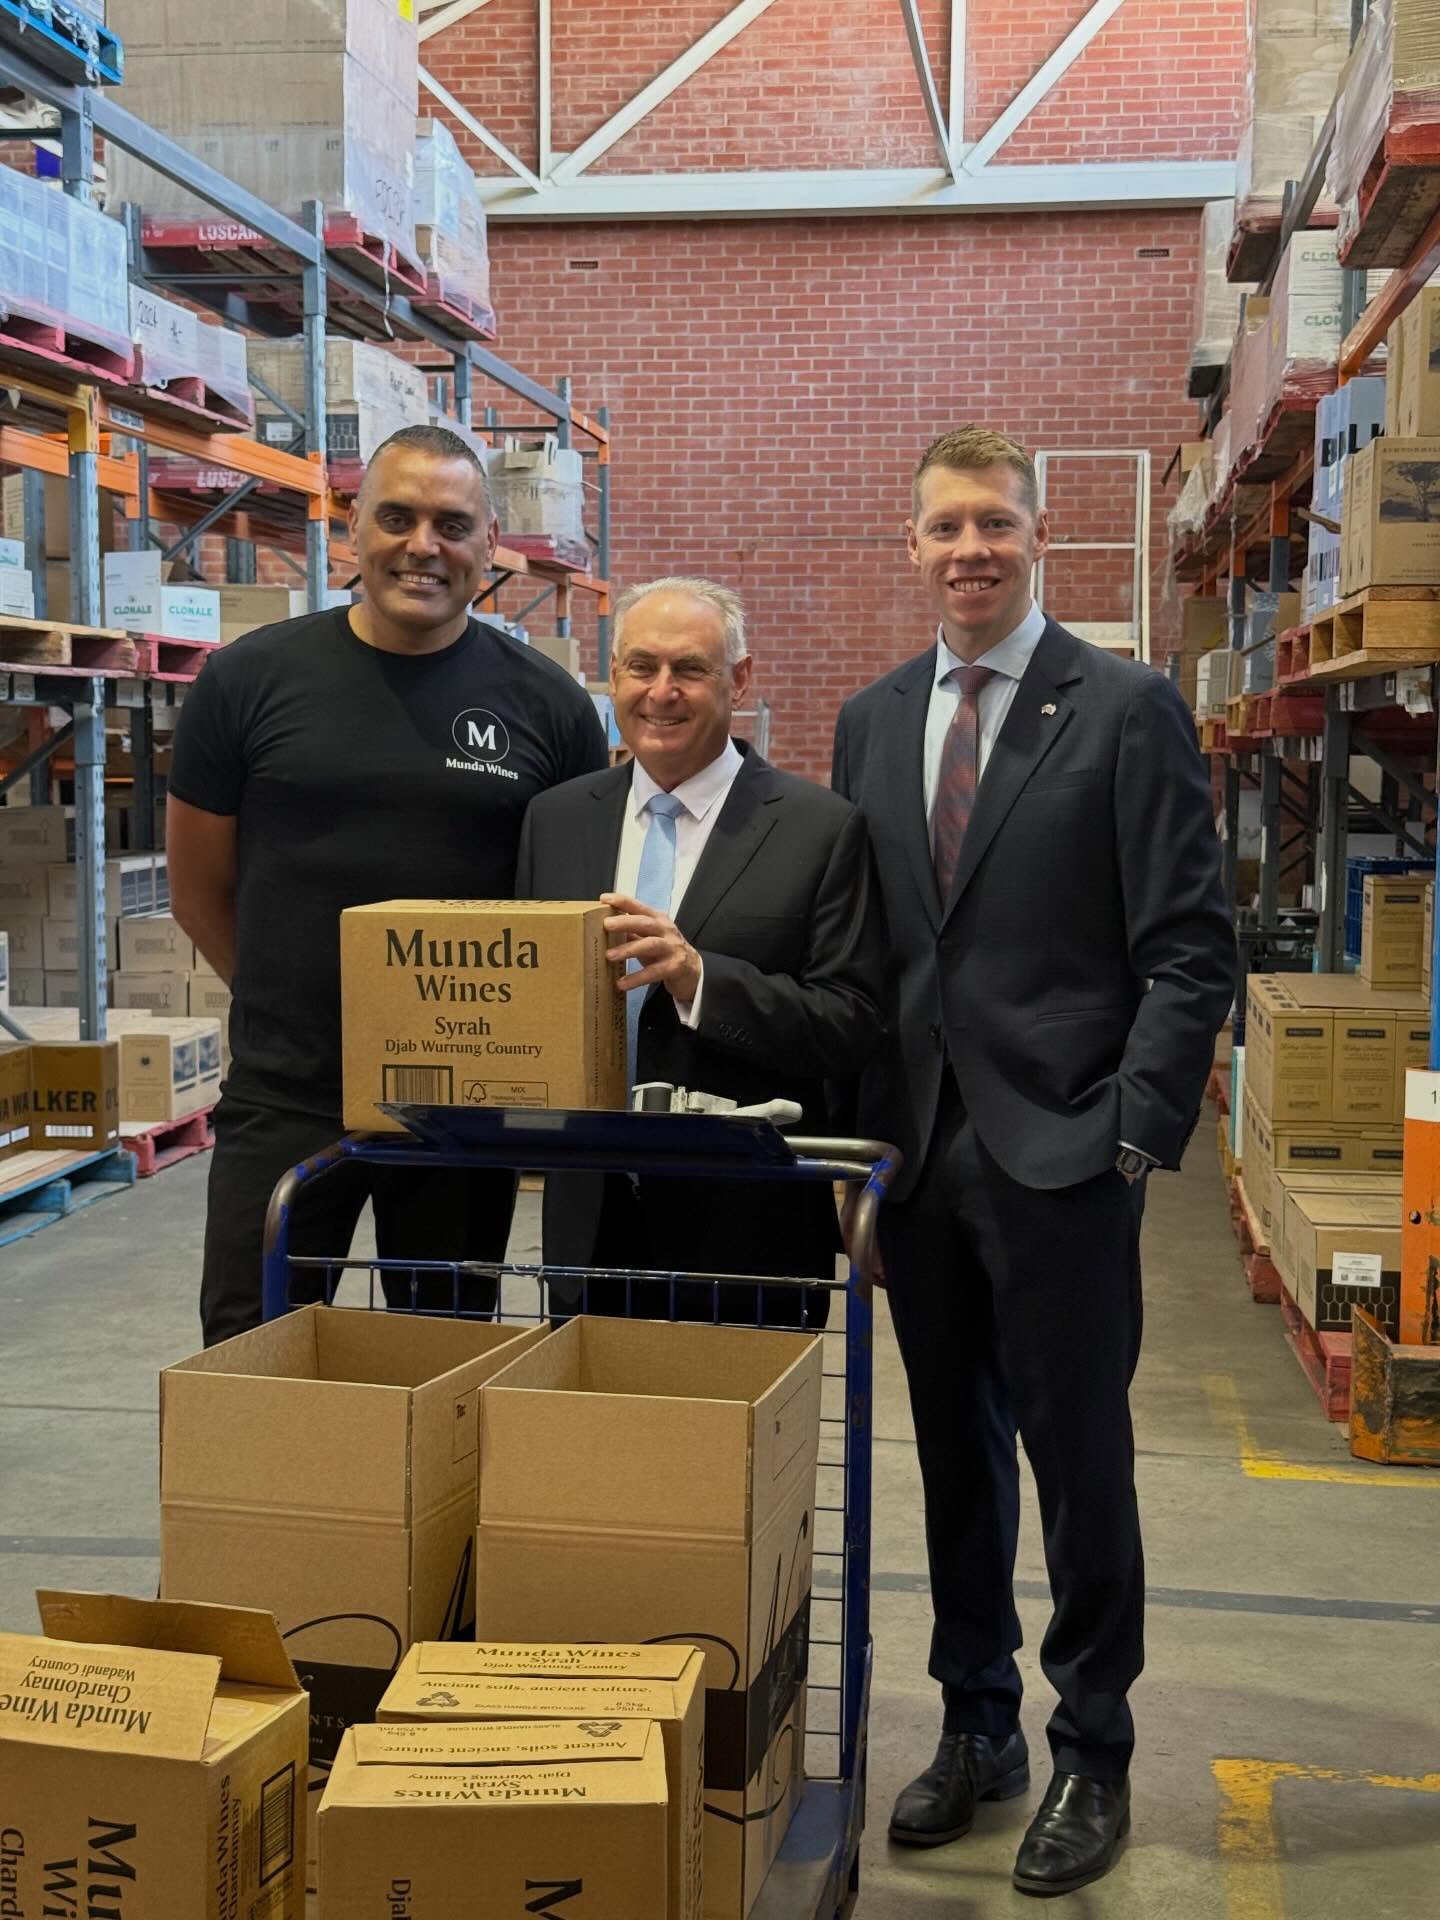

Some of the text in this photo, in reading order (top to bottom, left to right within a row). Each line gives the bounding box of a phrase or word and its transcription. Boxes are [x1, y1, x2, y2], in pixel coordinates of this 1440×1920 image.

[113, 606, 152, 615] CLONALE
[168, 606, 213, 616] CLONALE
[467, 720, 496, 750] M
[446, 757, 519, 780] Munda Wines
[385, 928, 540, 969] Munda
[414, 974, 512, 1003] Wines
[435, 1016, 491, 1039] Syrah
[385, 1039, 542, 1058] Djab Wurrung Country
[475, 1647, 641, 1659] Munda Wines
[530, 1656, 581, 1665] Syrah
[28, 1656, 136, 1682] Wadandi Country
[483, 1662, 628, 1671] Djab Wurrung Country
[19, 1671, 131, 1704] Chardonnay
[421, 1681, 480, 1689] Ancient
[530, 1685, 588, 1693] ancient
[65, 1702, 152, 1734] Munda
[448, 1745, 511, 1754] ancient
[564, 1742, 627, 1750] Ancient
[408, 1771, 571, 1781] Djab Wurrung Country
[394, 1786, 587, 1801] Munda Wines
[462, 1780, 520, 1790] Syrah
[217, 1775, 230, 1864] Wines
[0, 1827, 25, 1920] Chard
